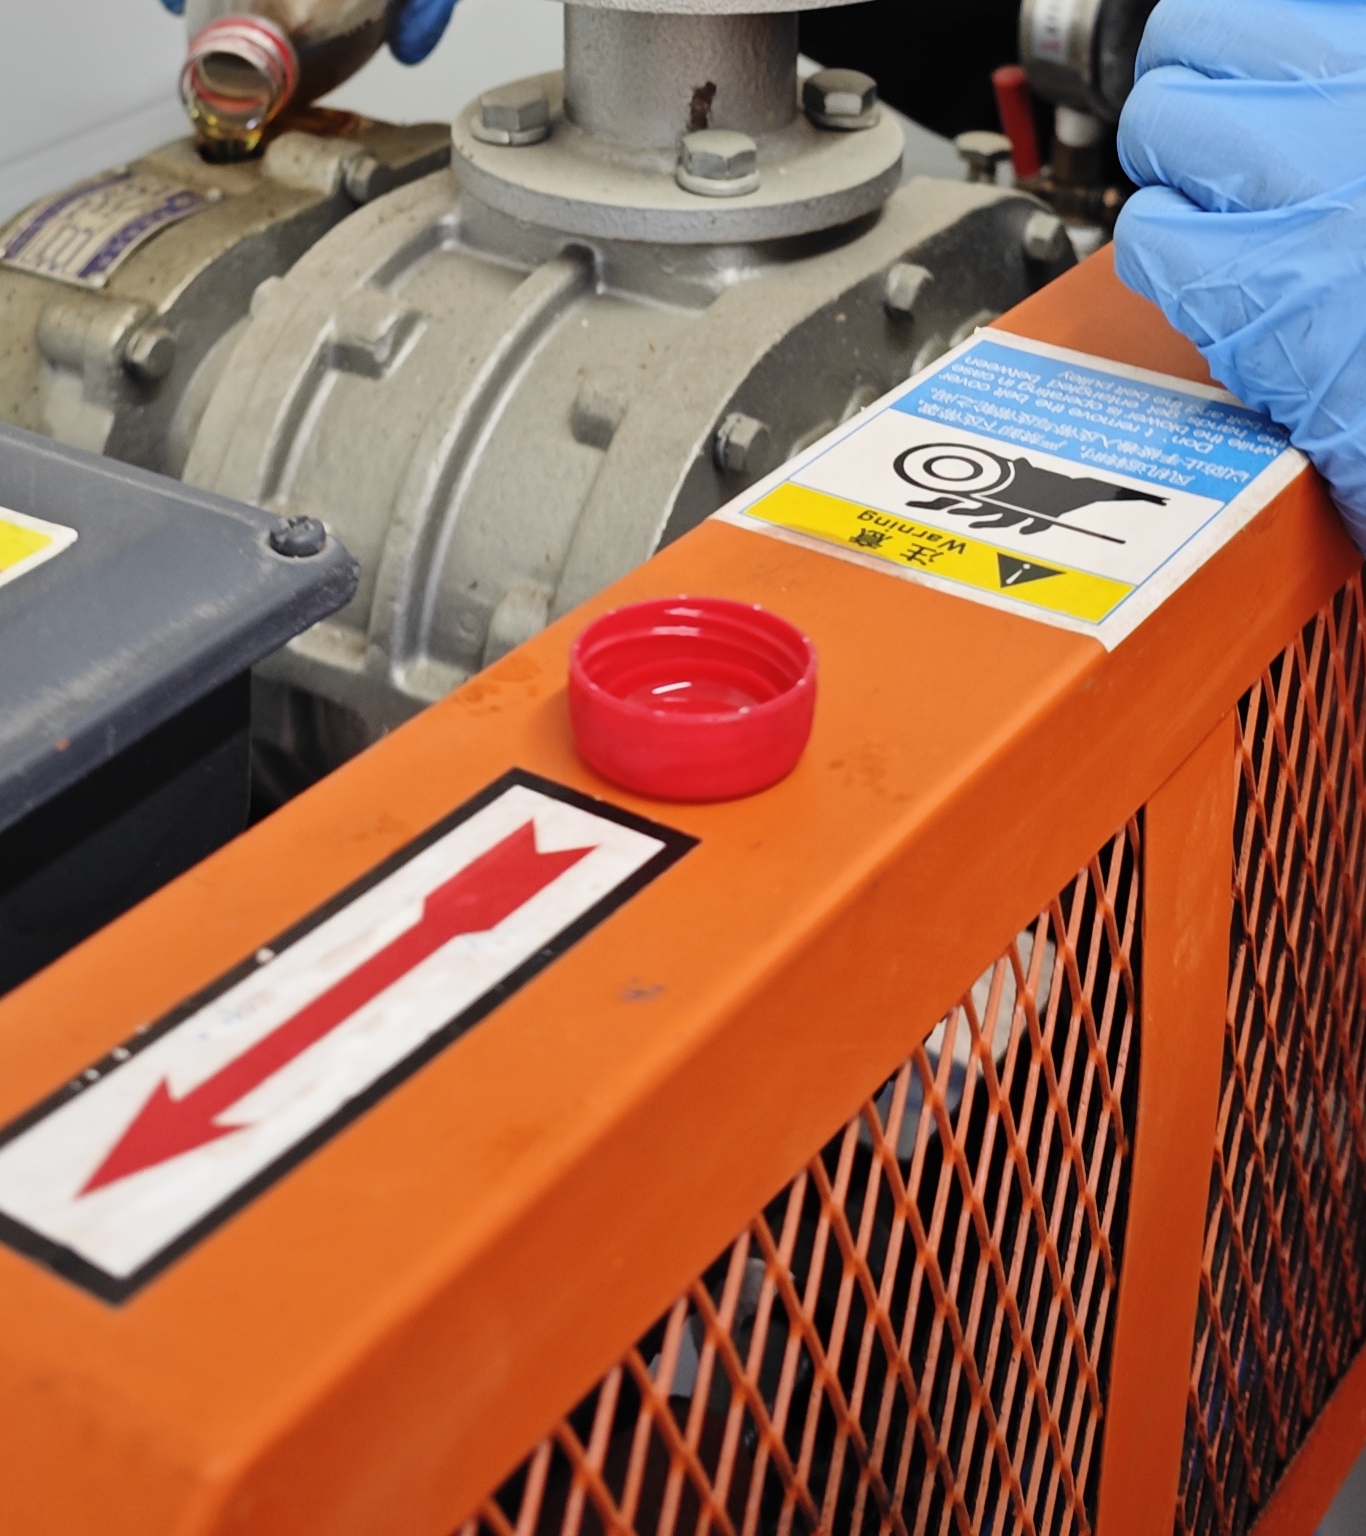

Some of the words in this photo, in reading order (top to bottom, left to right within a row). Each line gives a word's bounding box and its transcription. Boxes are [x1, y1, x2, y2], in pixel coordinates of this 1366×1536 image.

[951, 364, 995, 381] case
[964, 355, 1041, 383] between
[939, 373, 991, 391] cover
[998, 376, 1016, 388] in
[1057, 369, 1114, 392] pulley
[993, 386, 1029, 404] belt
[1017, 380, 1103, 410] operating
[1046, 379, 1139, 408] entangled
[1113, 384, 1150, 402] belt
[1152, 395, 1183, 408] the
[1035, 398, 1065, 413] the
[1146, 405, 1181, 420] get
[1185, 403, 1225, 419] and
[1068, 407, 1140, 432] remove
[1125, 411, 1190, 434] blower
[1187, 416, 1248, 438] hands
[1225, 414, 1263, 432] belt
[1193, 428, 1224, 444] the
[1256, 433, 1285, 448] the
[1228, 438, 1278, 456] while
[857, 509, 966, 555] Warning
[848, 528, 944, 566] 注意
